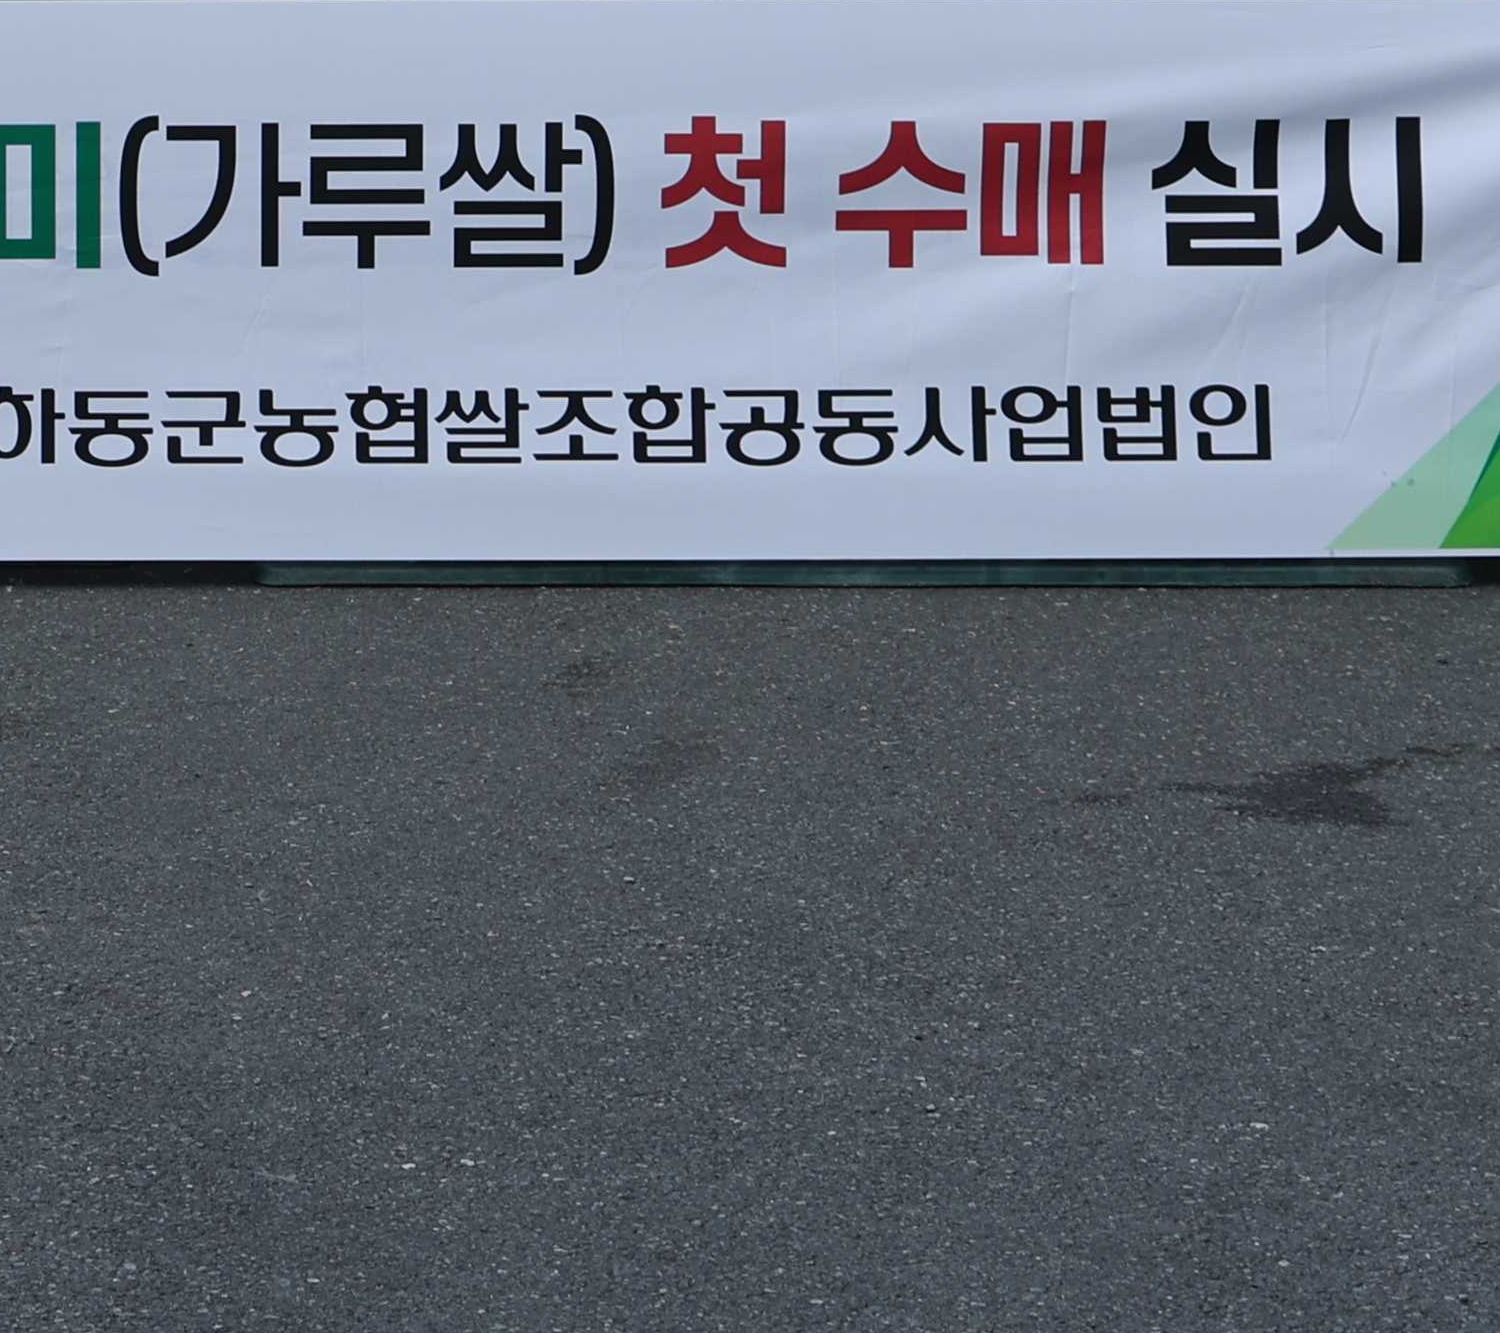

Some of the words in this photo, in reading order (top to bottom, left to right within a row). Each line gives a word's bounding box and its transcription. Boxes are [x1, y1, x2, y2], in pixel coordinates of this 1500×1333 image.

[661, 116, 787, 269] 첫
[835, 120, 1107, 269] 수매
[1152, 117, 1423, 267] 실시
